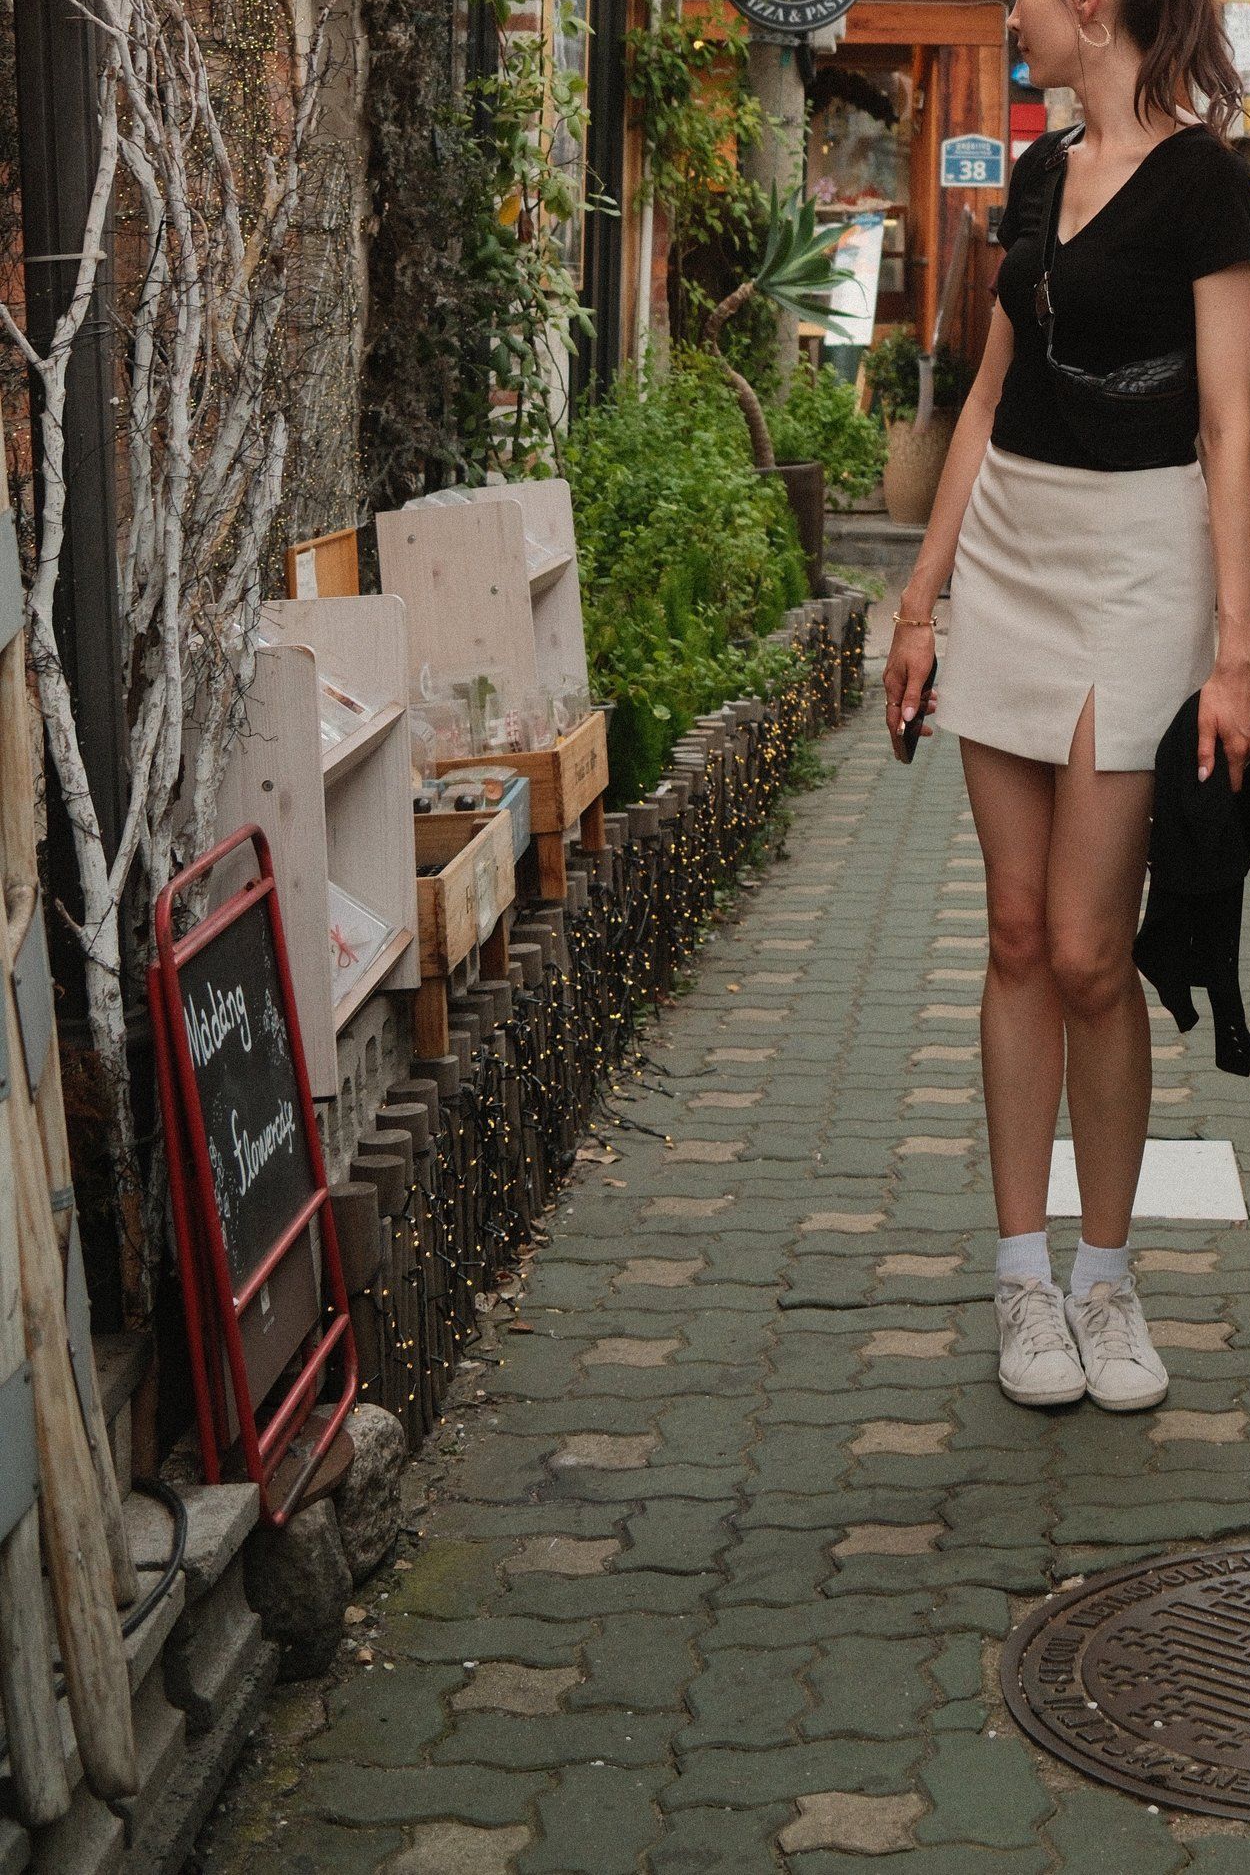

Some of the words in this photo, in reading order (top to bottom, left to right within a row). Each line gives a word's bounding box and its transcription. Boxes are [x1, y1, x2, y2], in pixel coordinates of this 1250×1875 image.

[788, 9, 802, 23] &
[959, 160, 987, 181] 38
[183, 981, 252, 1071] Madang
